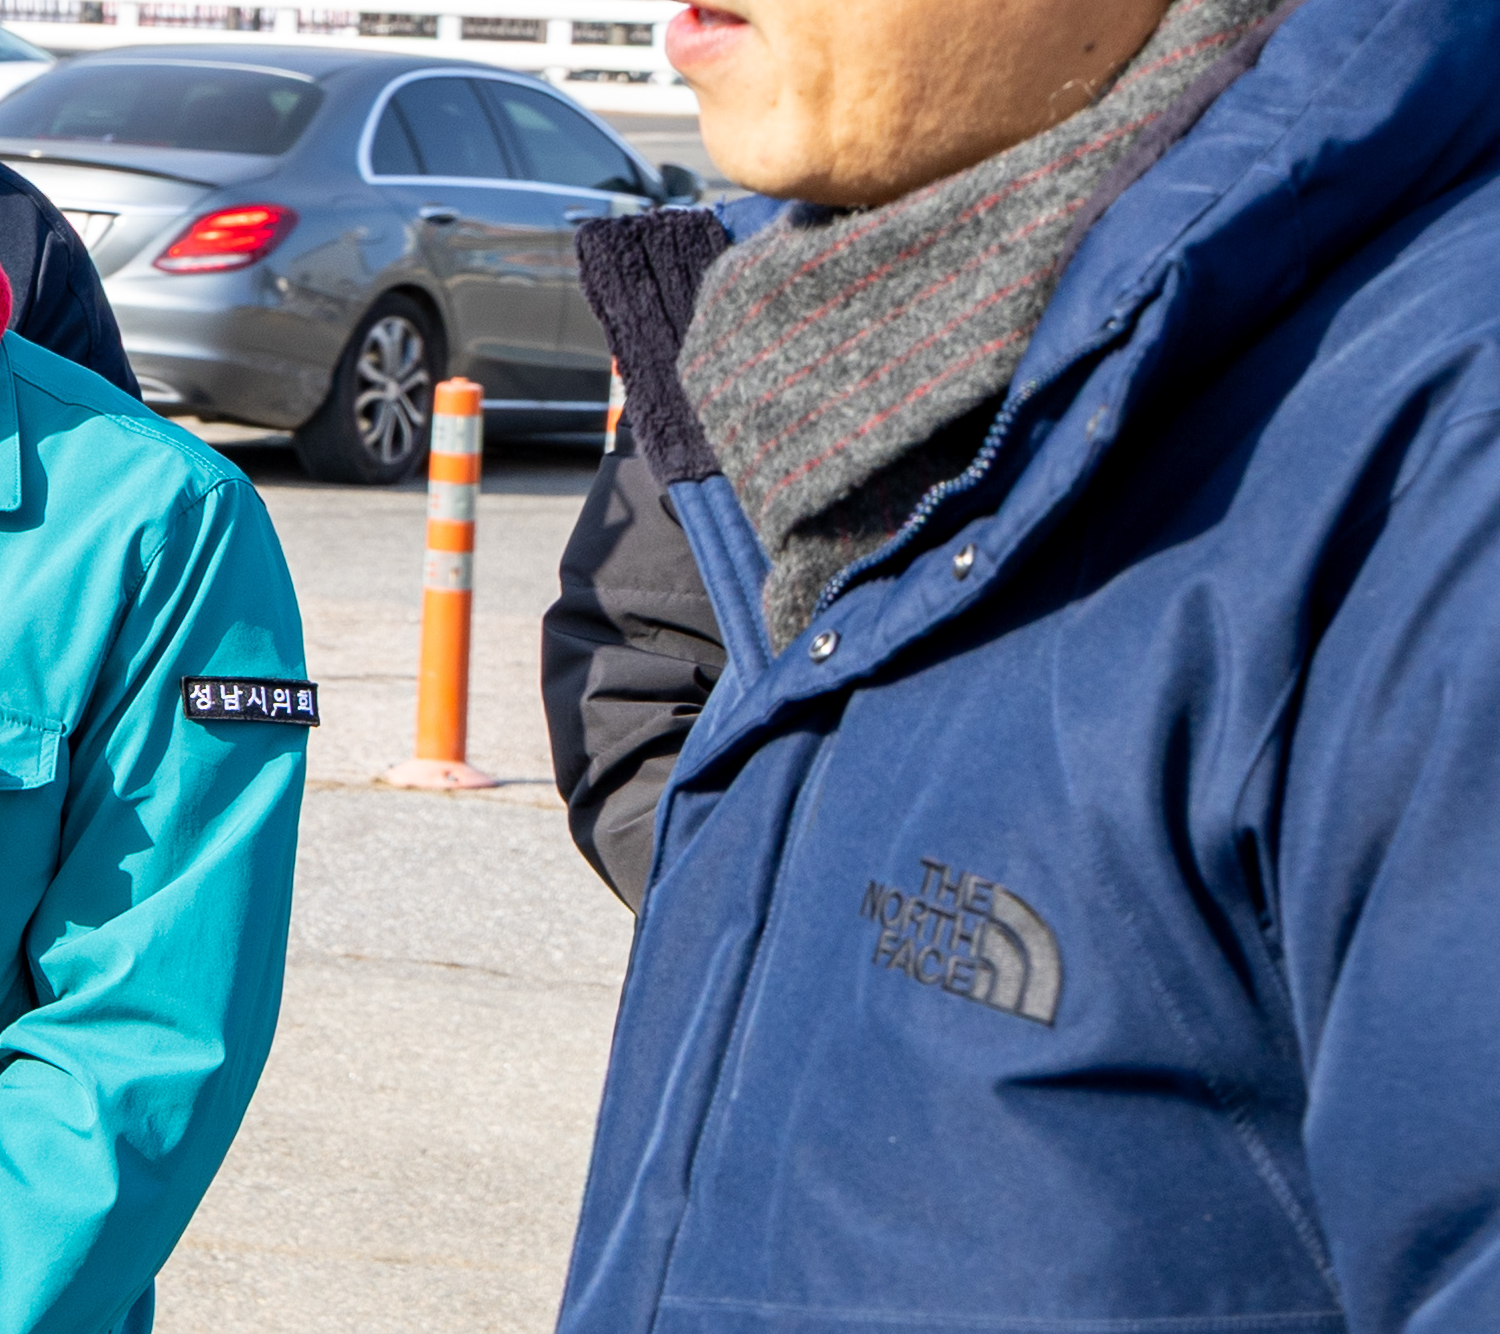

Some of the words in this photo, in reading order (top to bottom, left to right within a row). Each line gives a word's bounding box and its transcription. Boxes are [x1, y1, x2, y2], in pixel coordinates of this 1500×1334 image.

[190, 683, 315, 717] 성남시의회
[860, 879, 985, 958] NORTH
[920, 856, 995, 917] THE
[871, 929, 979, 997] FACE
